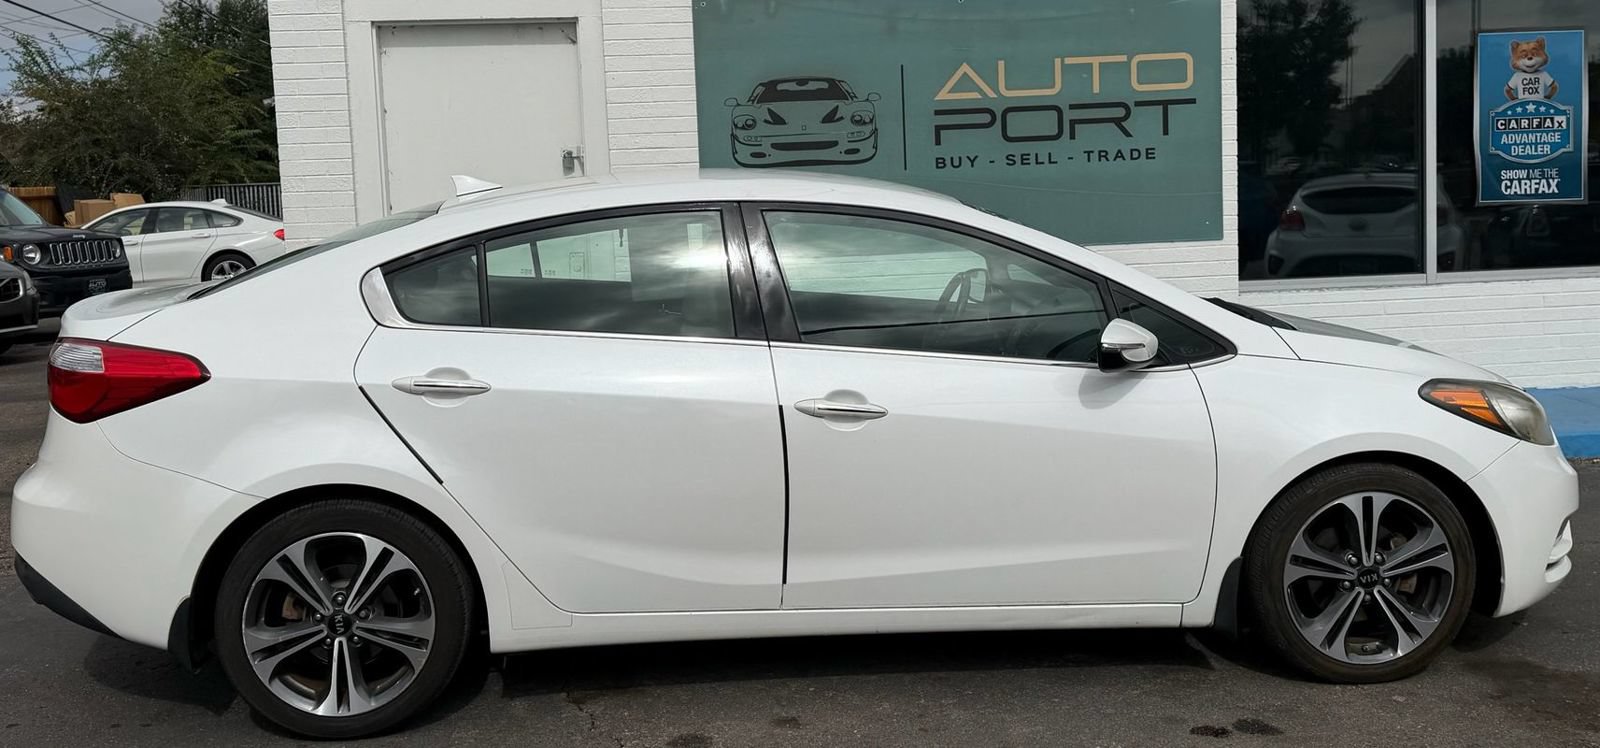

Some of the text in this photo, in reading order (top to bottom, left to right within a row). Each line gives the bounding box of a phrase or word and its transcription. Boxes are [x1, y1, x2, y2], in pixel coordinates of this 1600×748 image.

[934, 52, 1194, 100] AUTO
[1521, 77, 1540, 86] CAR
[1522, 86, 1540, 95] FOX
[934, 98, 1197, 146] PORT
[1497, 119, 1565, 130] CARFAX
[1501, 132, 1562, 144] ADVANTAGE
[1511, 144, 1551, 156] DEALER
[935, 155, 979, 169] BUY
[1005, 152, 1058, 167] SELL
[1083, 147, 1157, 163] TRADE
[1501, 168, 1559, 180] SHOW ME THE
[1501, 179, 1559, 195] CARFAX
[1360, 573, 1378, 584] KIA
[334, 614, 344, 634] KIA
